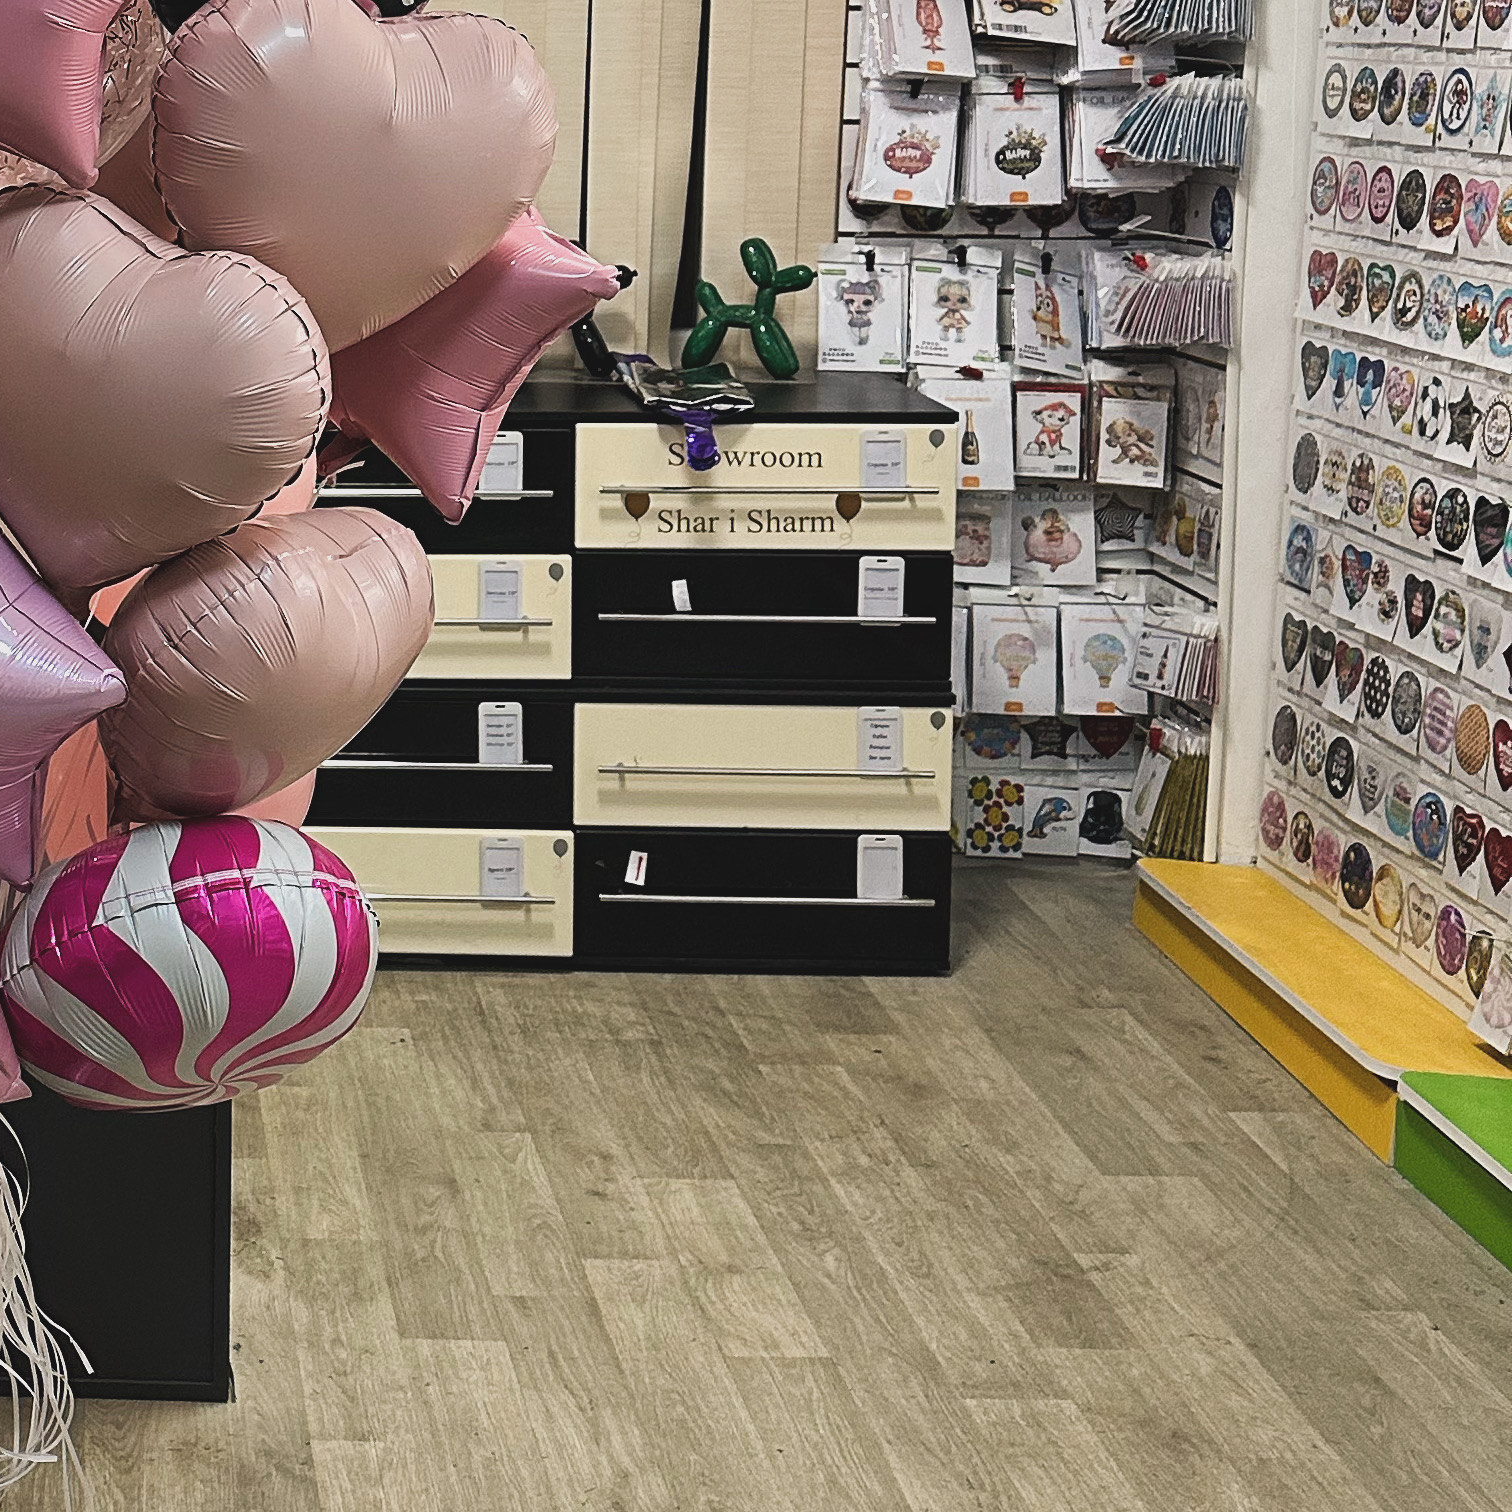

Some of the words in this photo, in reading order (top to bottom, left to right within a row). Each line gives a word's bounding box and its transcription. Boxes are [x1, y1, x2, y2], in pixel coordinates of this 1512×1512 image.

[668, 442, 824, 468] Swroom
[657, 509, 720, 533] Shar
[728, 509, 736, 532] i
[747, 509, 836, 534] Sharm
